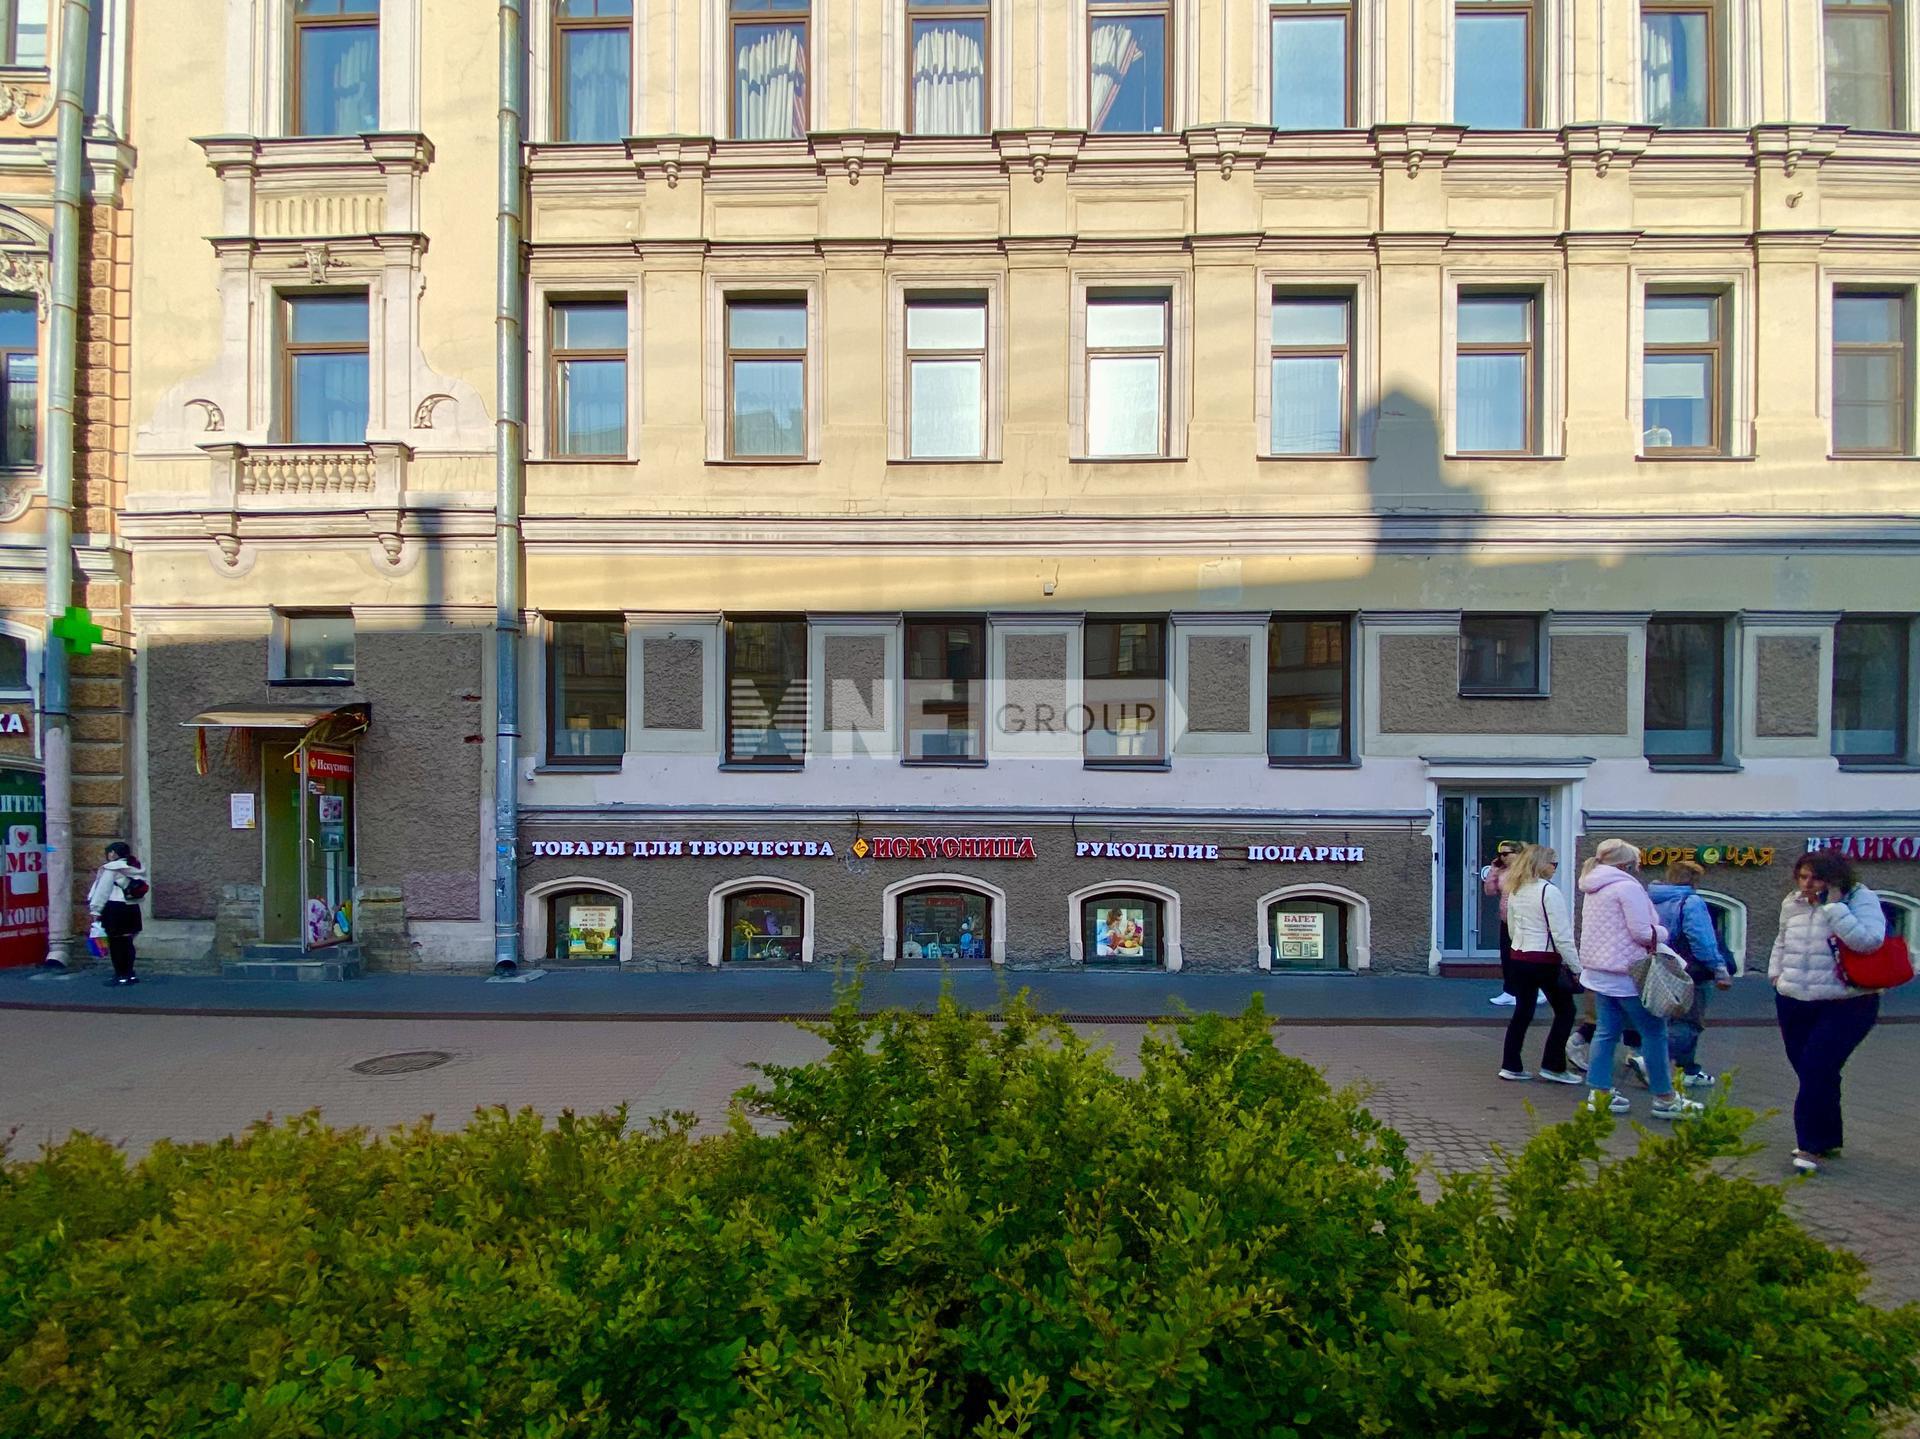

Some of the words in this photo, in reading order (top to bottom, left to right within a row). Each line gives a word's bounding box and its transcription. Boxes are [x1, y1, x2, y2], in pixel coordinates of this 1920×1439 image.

[532, 841, 626, 856] ТОВАРЫ
[633, 841, 683, 857] ДЛЯ
[689, 841, 835, 856] ТВОРЧЕСТВА
[872, 837, 1037, 859] ИСКУСНИЦА
[1076, 842, 1219, 860] РУКОДЕЛИЕ
[1248, 845, 1365, 862] ПОДАРКИ
[1726, 846, 1776, 866] ЧАЯ
[1284, 915, 1317, 923] БАГЕТ
